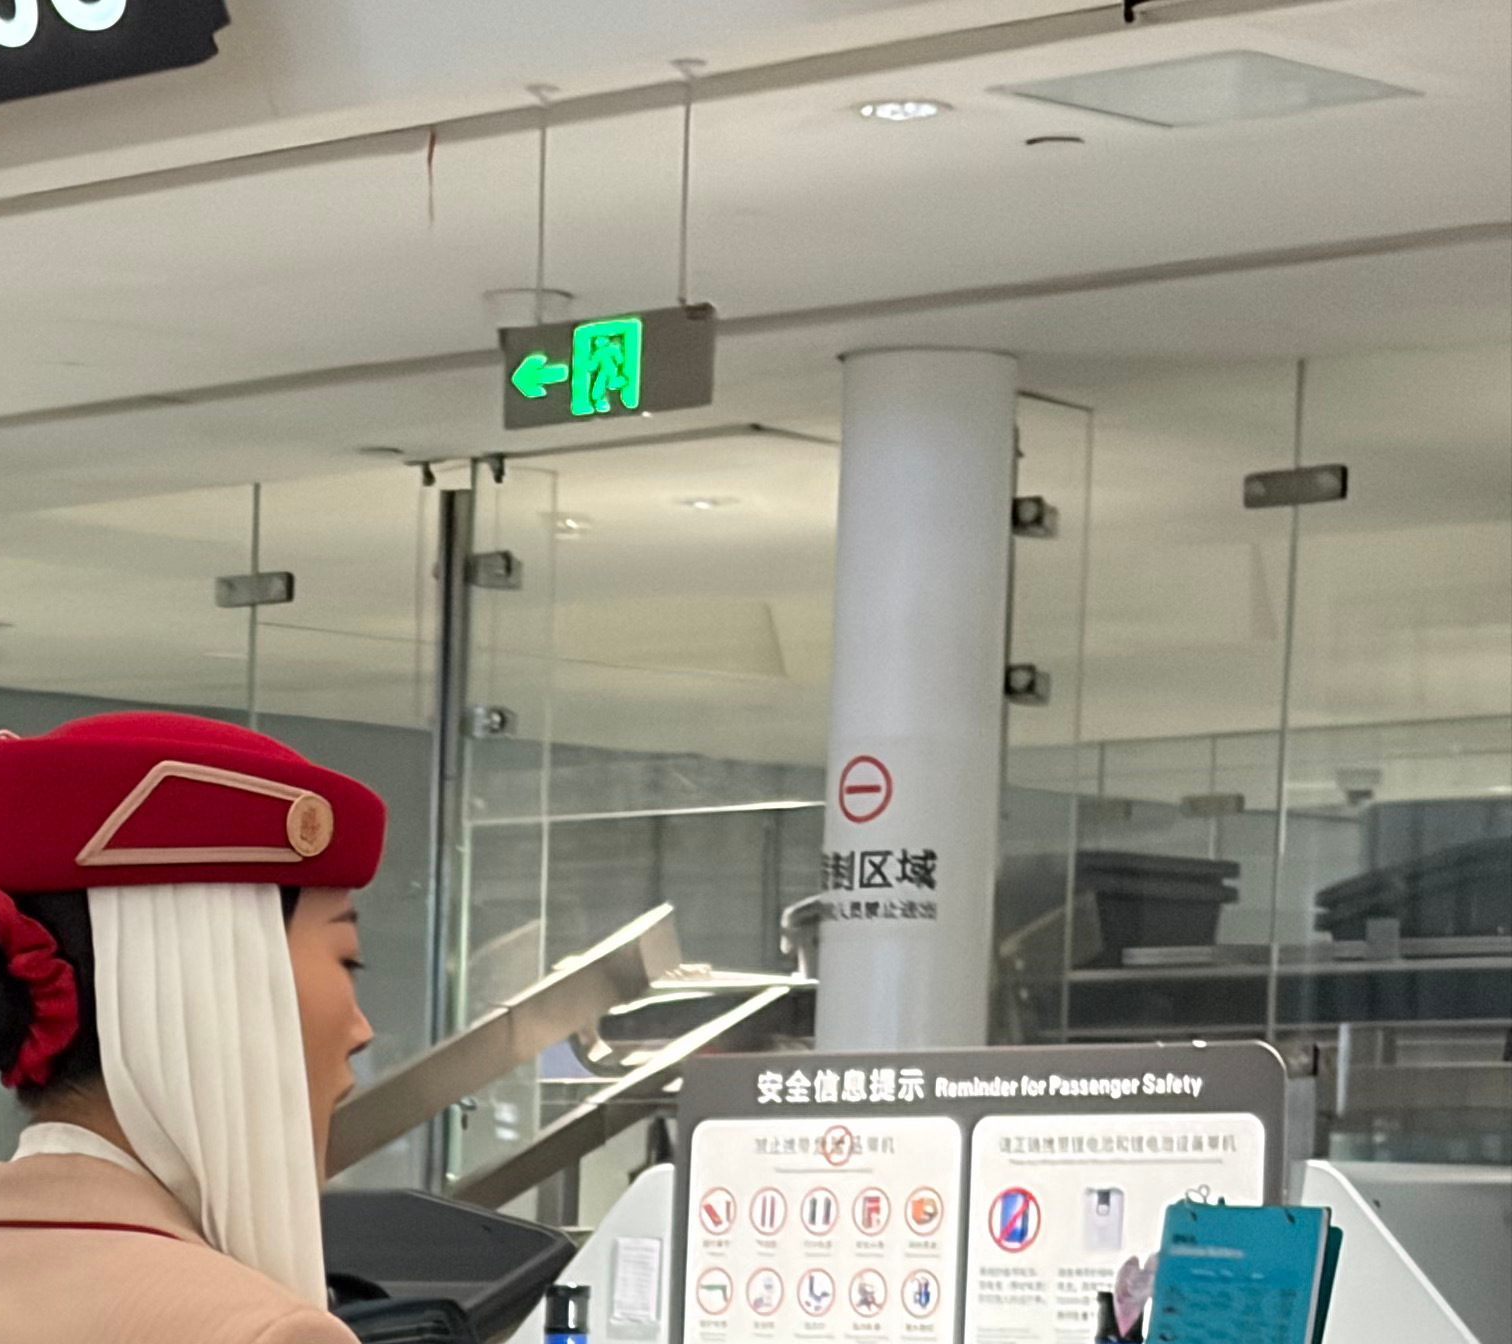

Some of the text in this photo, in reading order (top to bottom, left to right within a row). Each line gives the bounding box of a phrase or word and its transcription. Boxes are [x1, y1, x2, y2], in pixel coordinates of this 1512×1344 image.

[822, 848, 937, 891] 制区域
[757, 1068, 1203, 1104] 安全信息提示 Reminder for Passenger Safety
